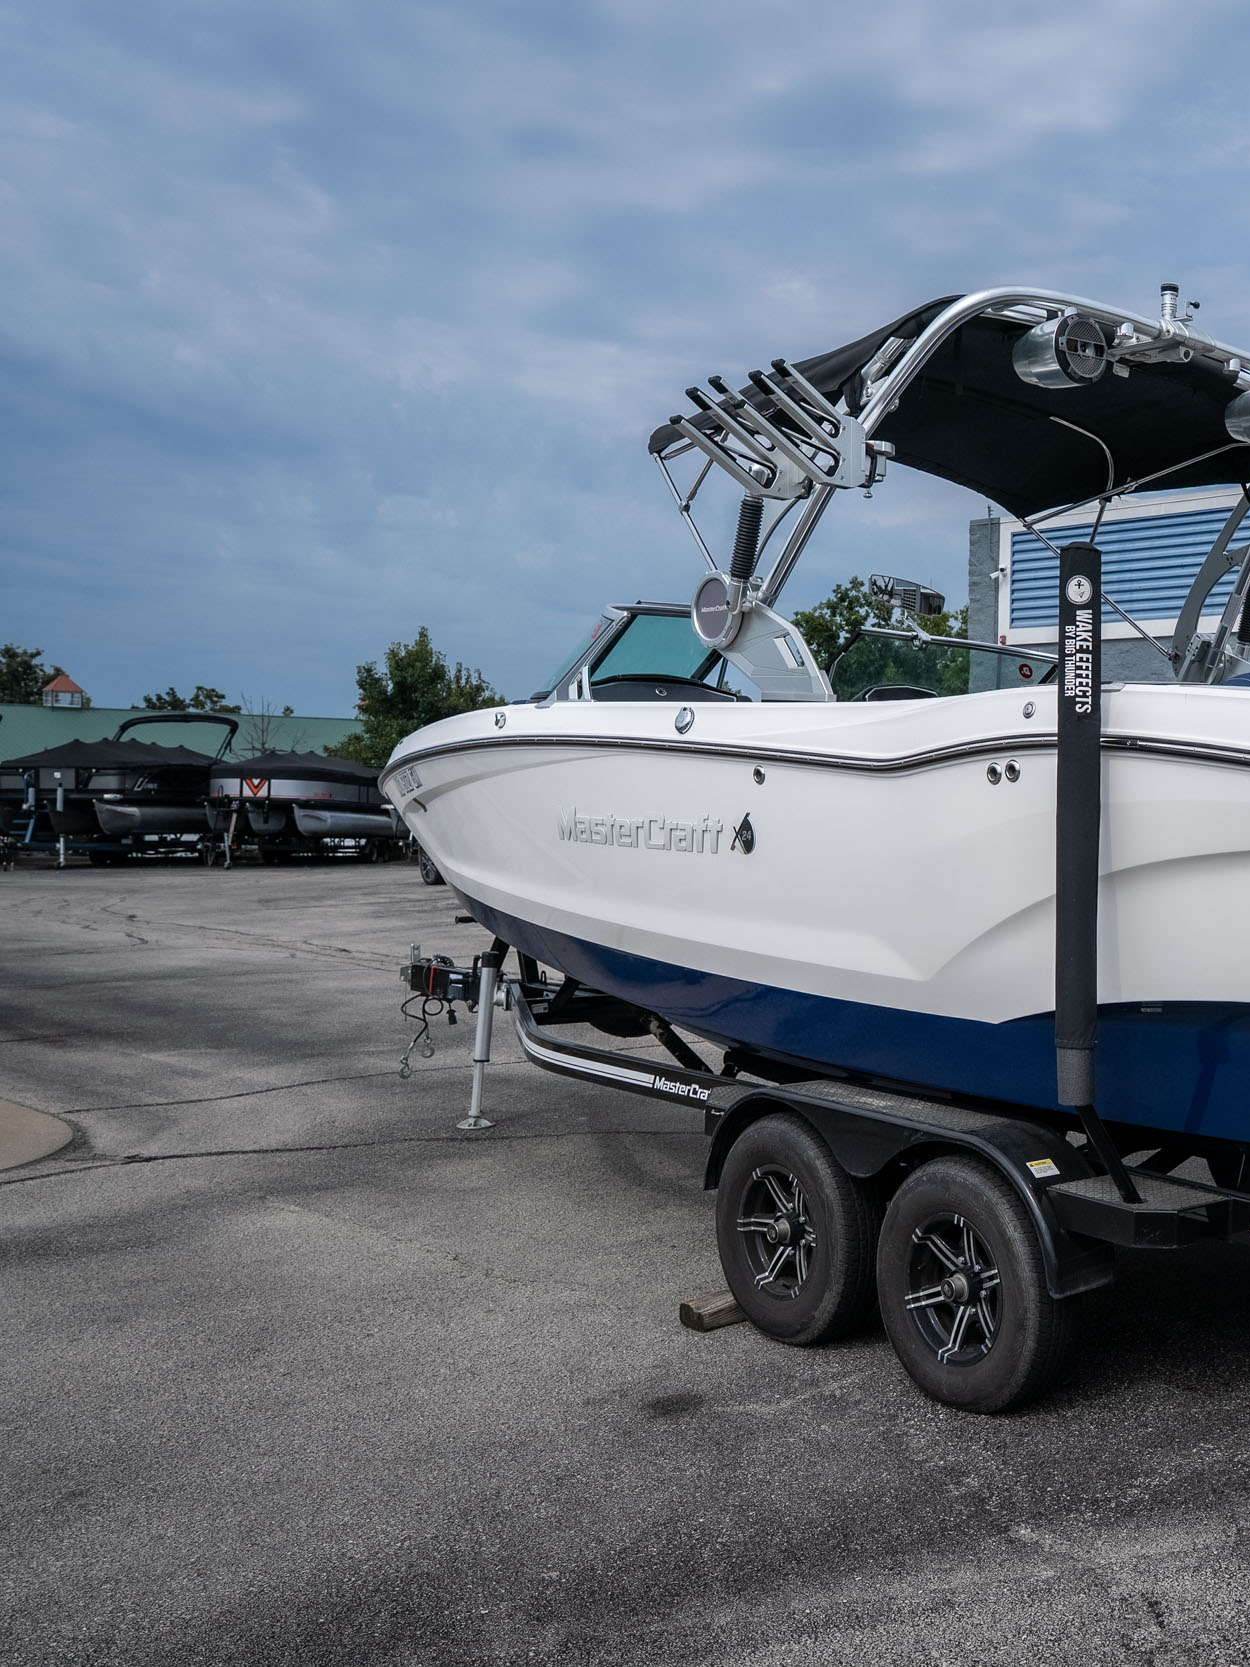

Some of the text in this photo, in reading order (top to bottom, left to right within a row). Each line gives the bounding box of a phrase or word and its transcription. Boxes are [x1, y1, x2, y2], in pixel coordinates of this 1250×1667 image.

[1064, 625, 1076, 698] BY BIG THUNDER
[1075, 609, 1093, 714] WAKE EFFECTS
[557, 805, 724, 855] MasterCraft
